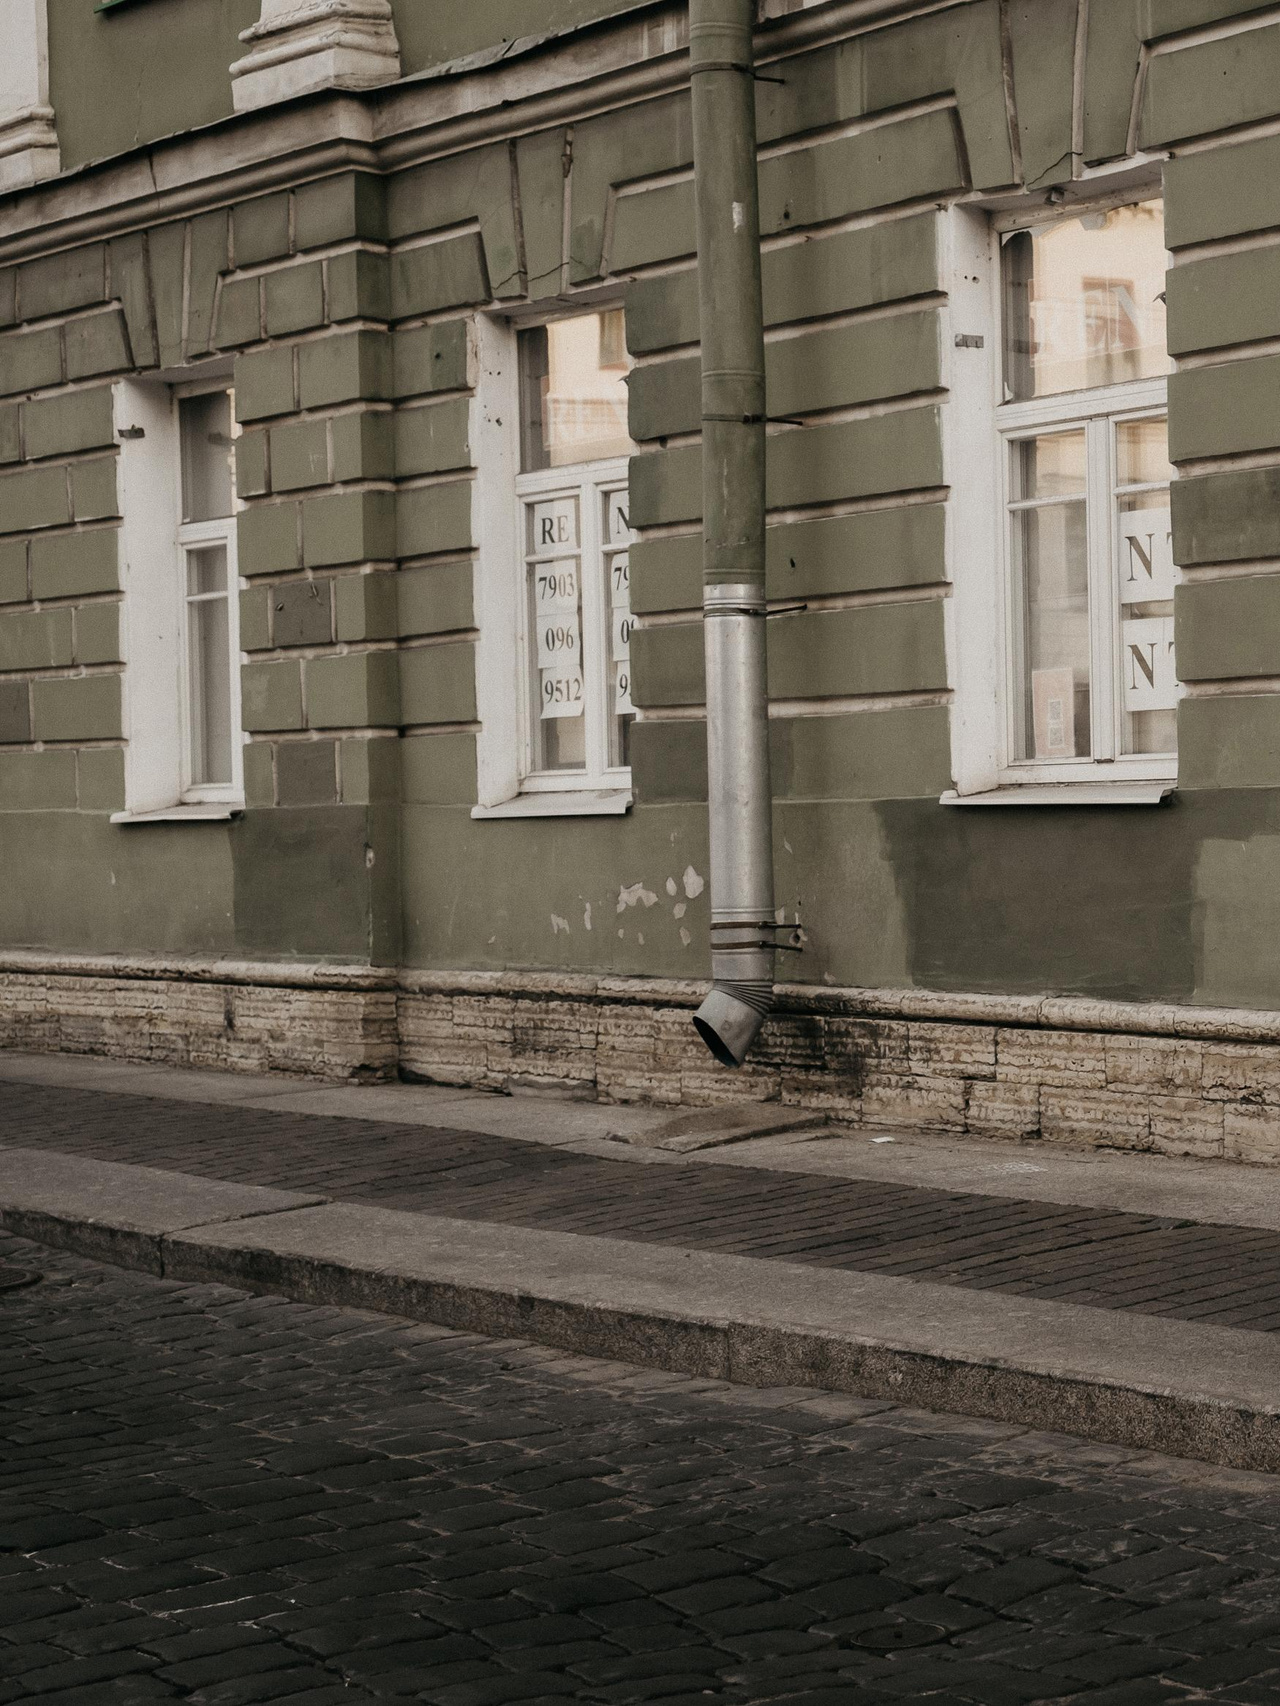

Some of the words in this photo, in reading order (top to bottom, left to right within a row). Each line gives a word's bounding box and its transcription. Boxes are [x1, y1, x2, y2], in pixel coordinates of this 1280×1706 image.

[541, 515, 569, 545] RE
[538, 573, 575, 600] 7903
[545, 625, 574, 652] 096
[620, 618, 634, 645] 0
[545, 677, 581, 704] 9512
